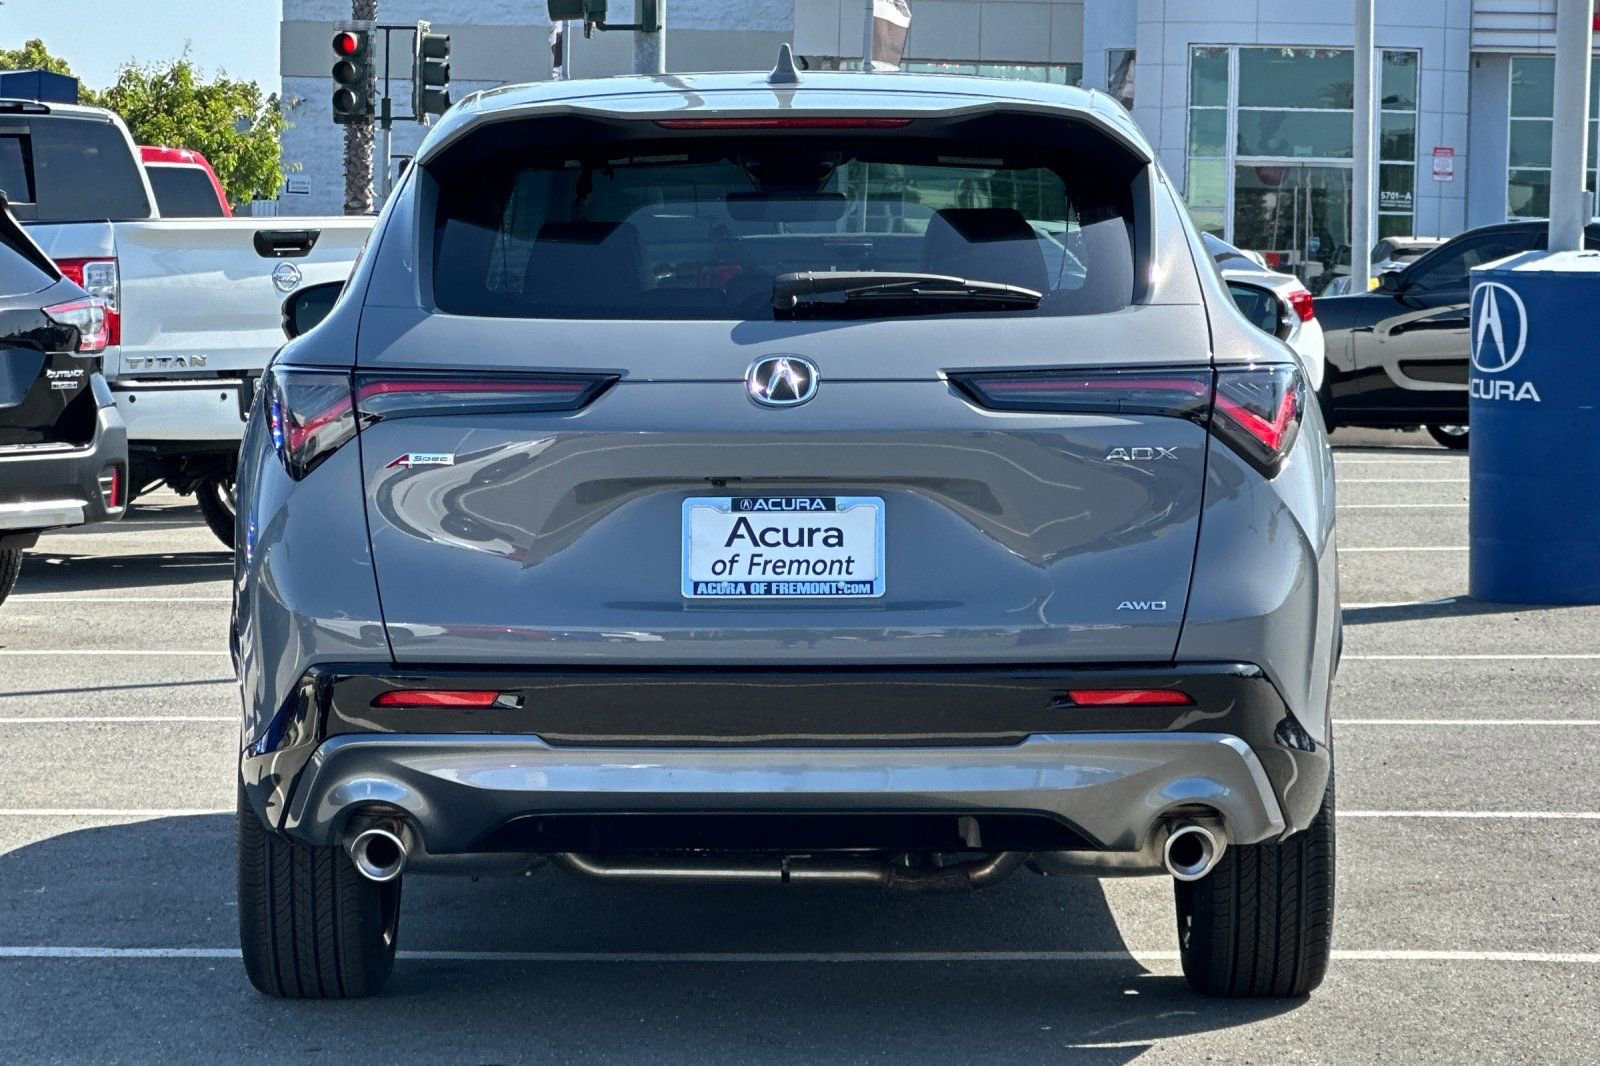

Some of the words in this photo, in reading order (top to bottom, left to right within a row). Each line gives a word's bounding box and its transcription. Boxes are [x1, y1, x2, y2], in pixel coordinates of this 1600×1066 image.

[126, 356, 207, 369] TITAN
[1470, 378, 1541, 402] CURA
[1104, 446, 1178, 461] ADX
[753, 498, 826, 511] ACURA
[724, 516, 844, 548] Acura
[711, 553, 740, 576] of
[747, 553, 855, 576] Fremont
[697, 582, 747, 595] ACURA
[751, 582, 767, 595] OF
[1115, 600, 1167, 611] AWD
